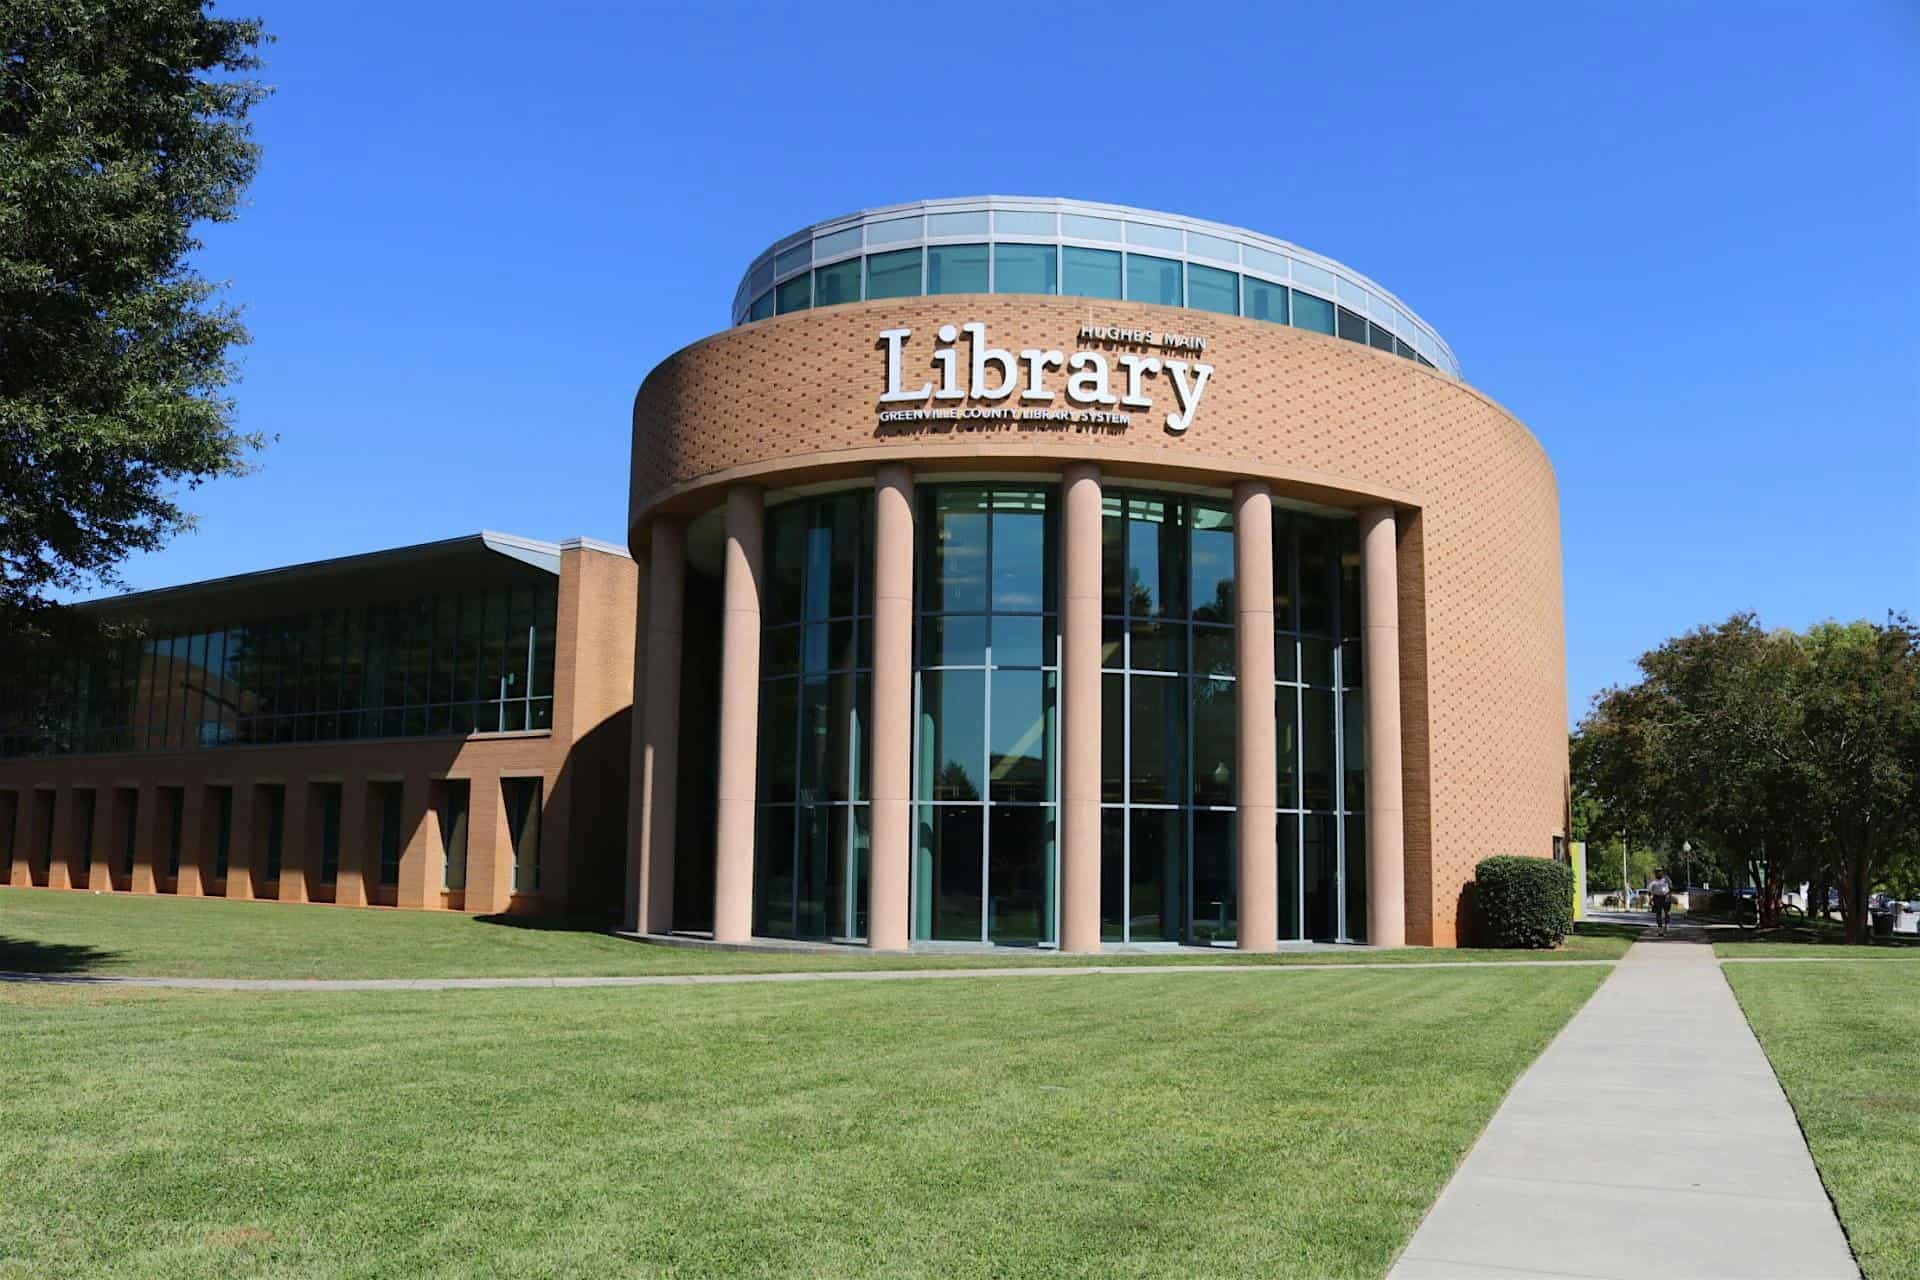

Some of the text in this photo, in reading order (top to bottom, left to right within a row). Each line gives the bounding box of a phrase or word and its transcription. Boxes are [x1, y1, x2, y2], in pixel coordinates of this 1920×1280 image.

[1080, 325, 1207, 349] HUGHES MAIN
[879, 322, 1214, 431] Library
[880, 408, 1130, 424] GREENVILLE COUNTY LIBRARY SYSTEM
